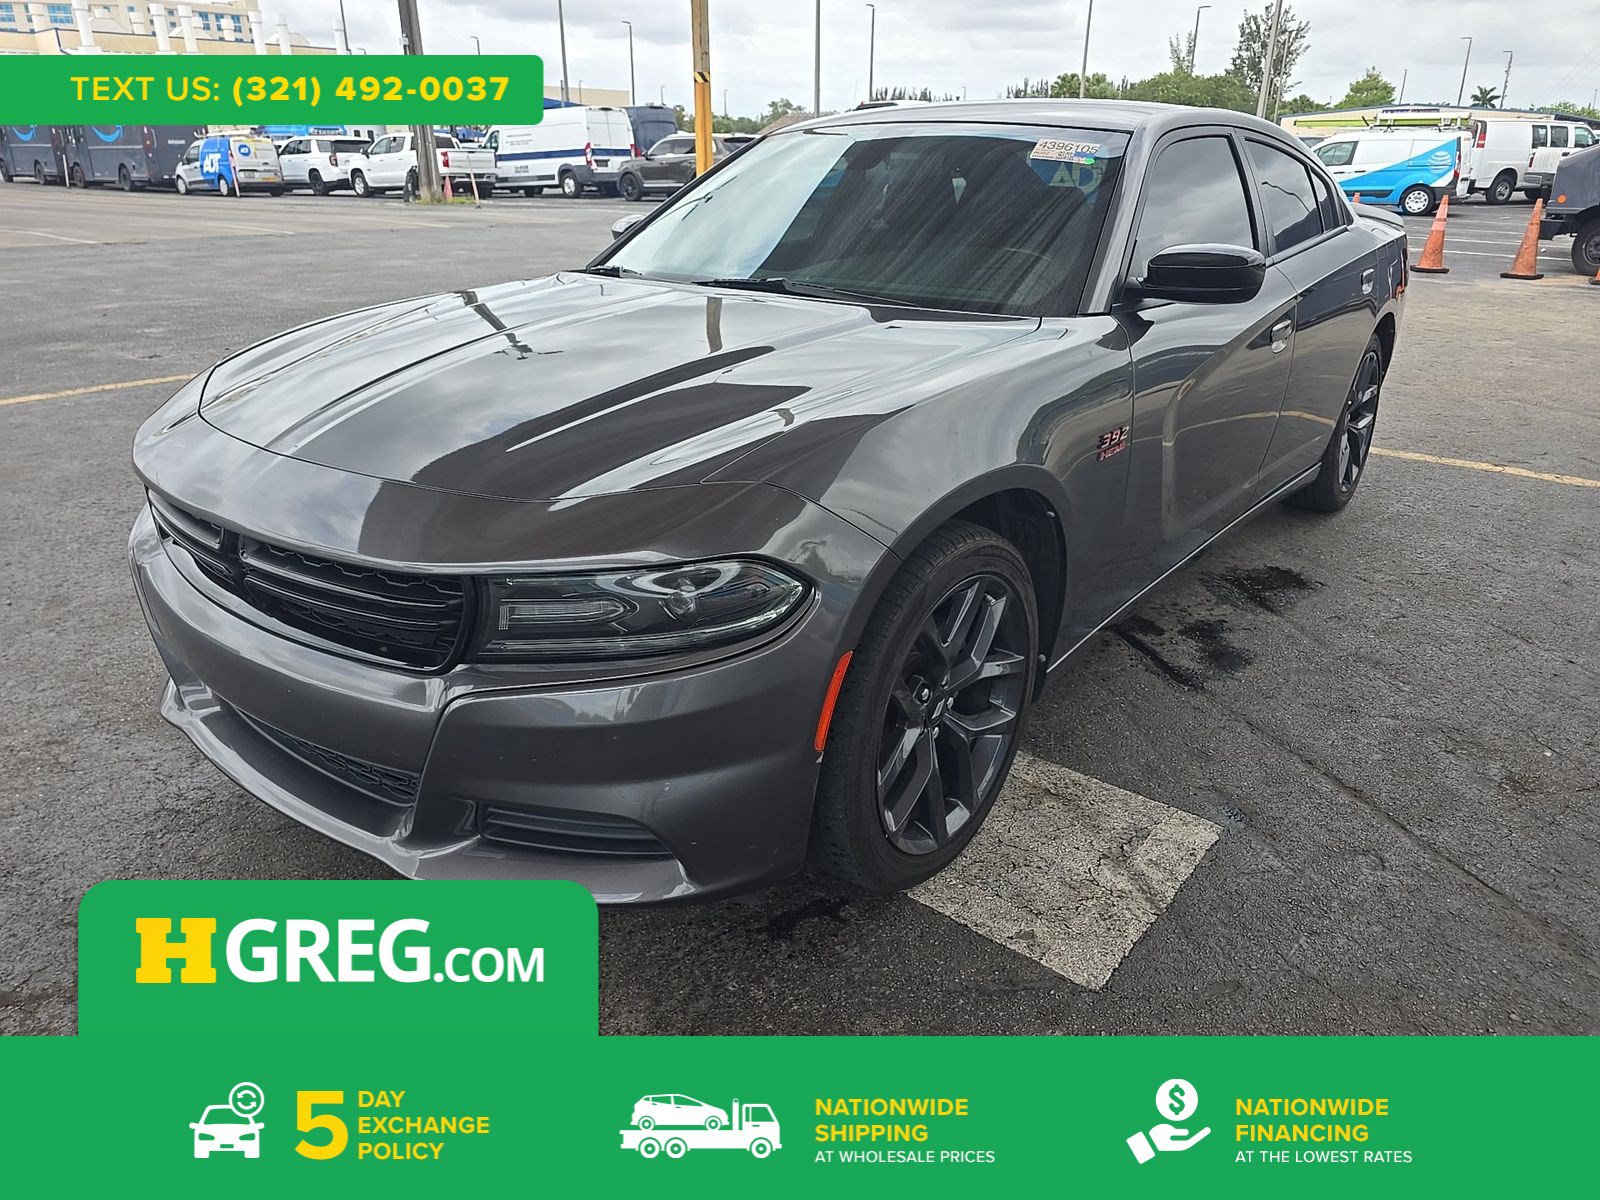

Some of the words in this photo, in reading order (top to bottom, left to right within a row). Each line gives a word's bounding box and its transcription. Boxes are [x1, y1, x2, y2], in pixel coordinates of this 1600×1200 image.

[1038, 141, 1100, 154] 4396105
[203, 153, 221, 173] ADT
[1097, 425, 1130, 449] 392
